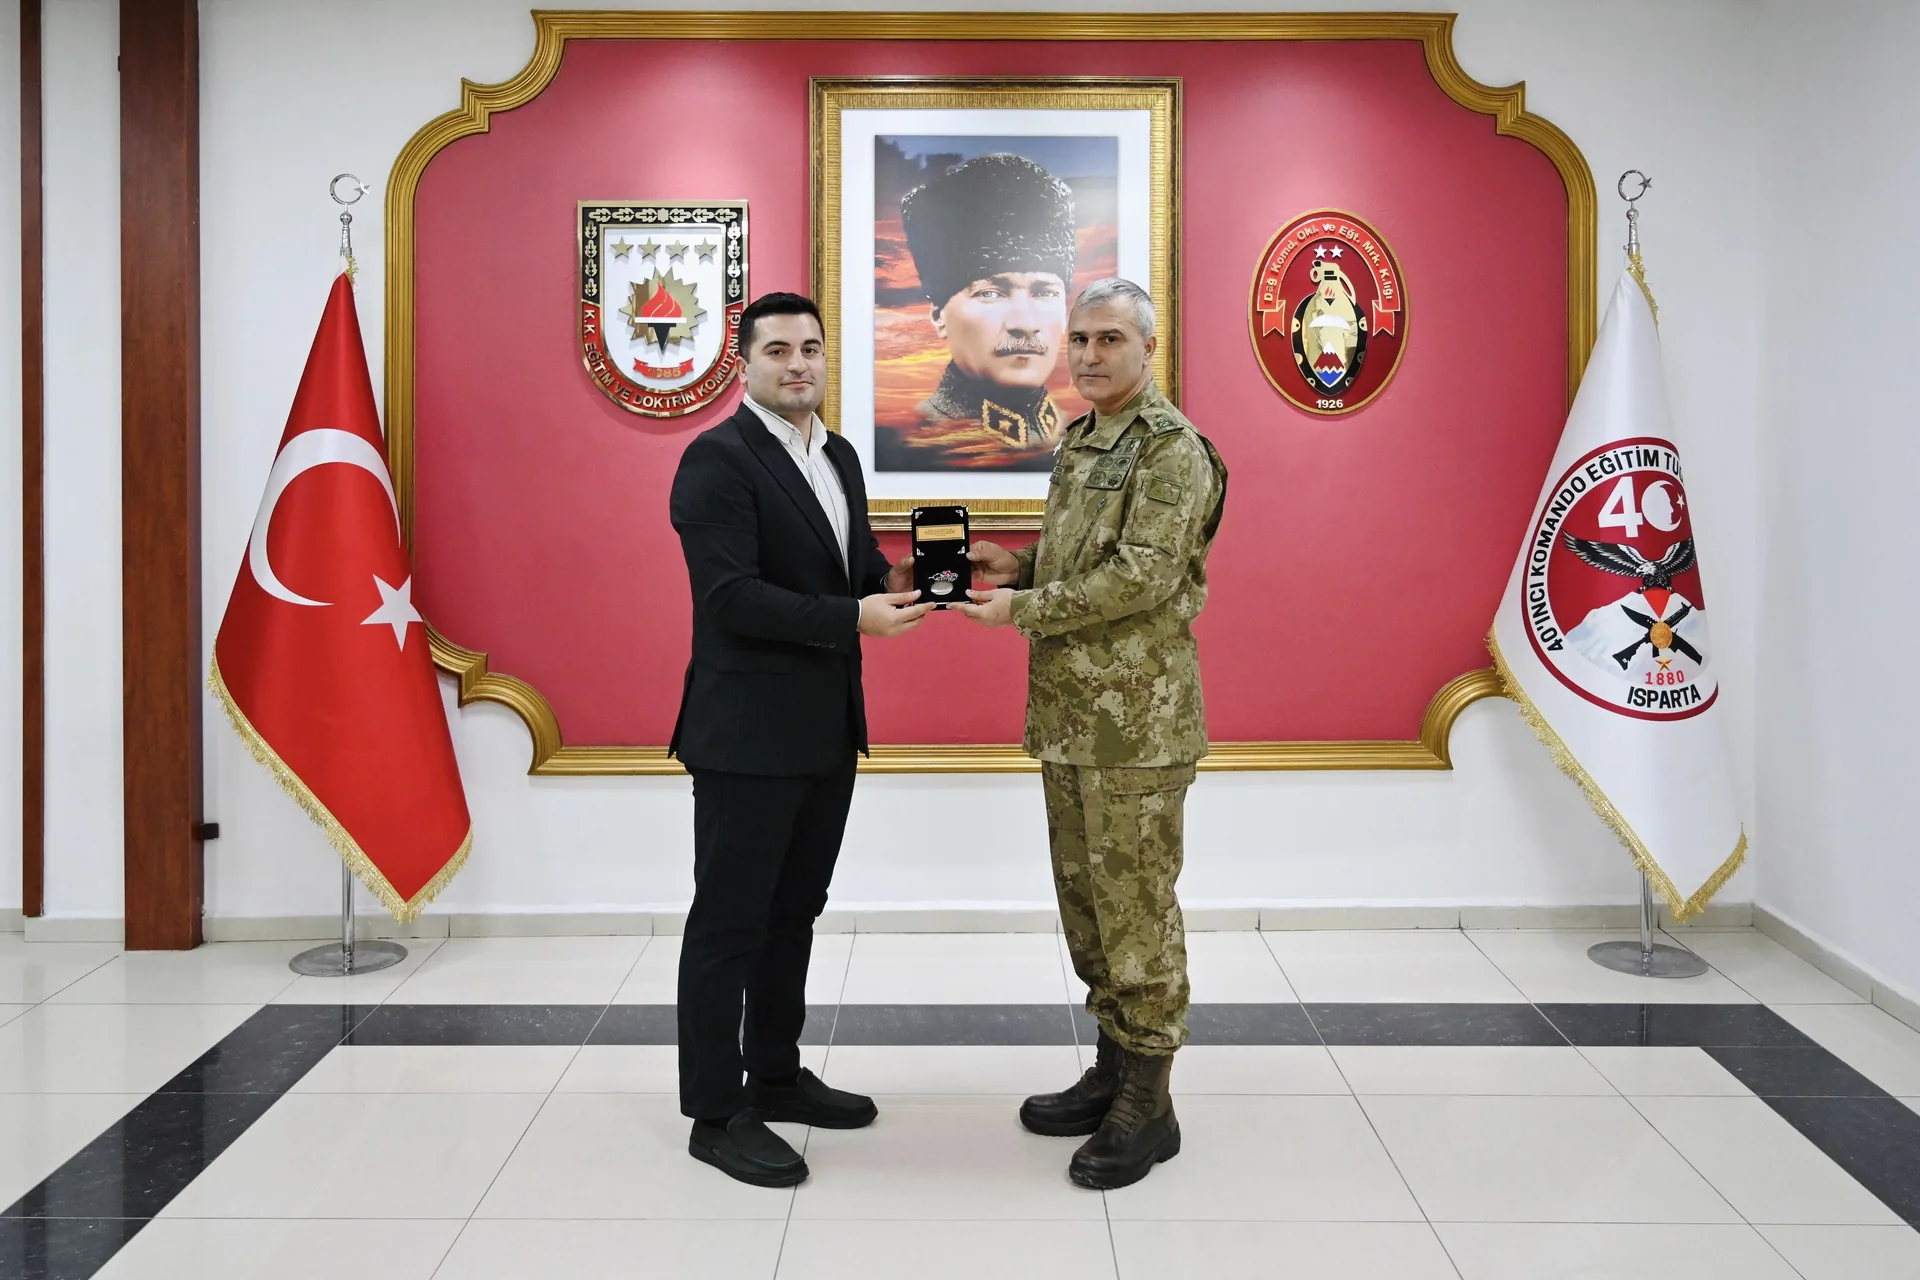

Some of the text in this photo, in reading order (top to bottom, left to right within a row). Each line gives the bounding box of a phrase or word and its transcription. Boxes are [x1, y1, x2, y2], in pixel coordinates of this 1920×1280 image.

[1322, 223, 1336, 232] ve
[1270, 240, 1297, 273] Komd.
[1362, 241, 1380, 267] Mrk.
[1263, 278, 1278, 301] Dağ
[584, 342, 615, 386] EĞİTİM
[615, 381, 632, 400] VE
[633, 390, 697, 409] DOKTRİN
[1316, 399, 1344, 409] 1926
[1532, 475, 1587, 577] KOMANDO
[1585, 445, 1660, 483] EĞİTİM
[1645, 670, 1685, 686] 1880
[1627, 684, 1702, 709] ISPARTA
